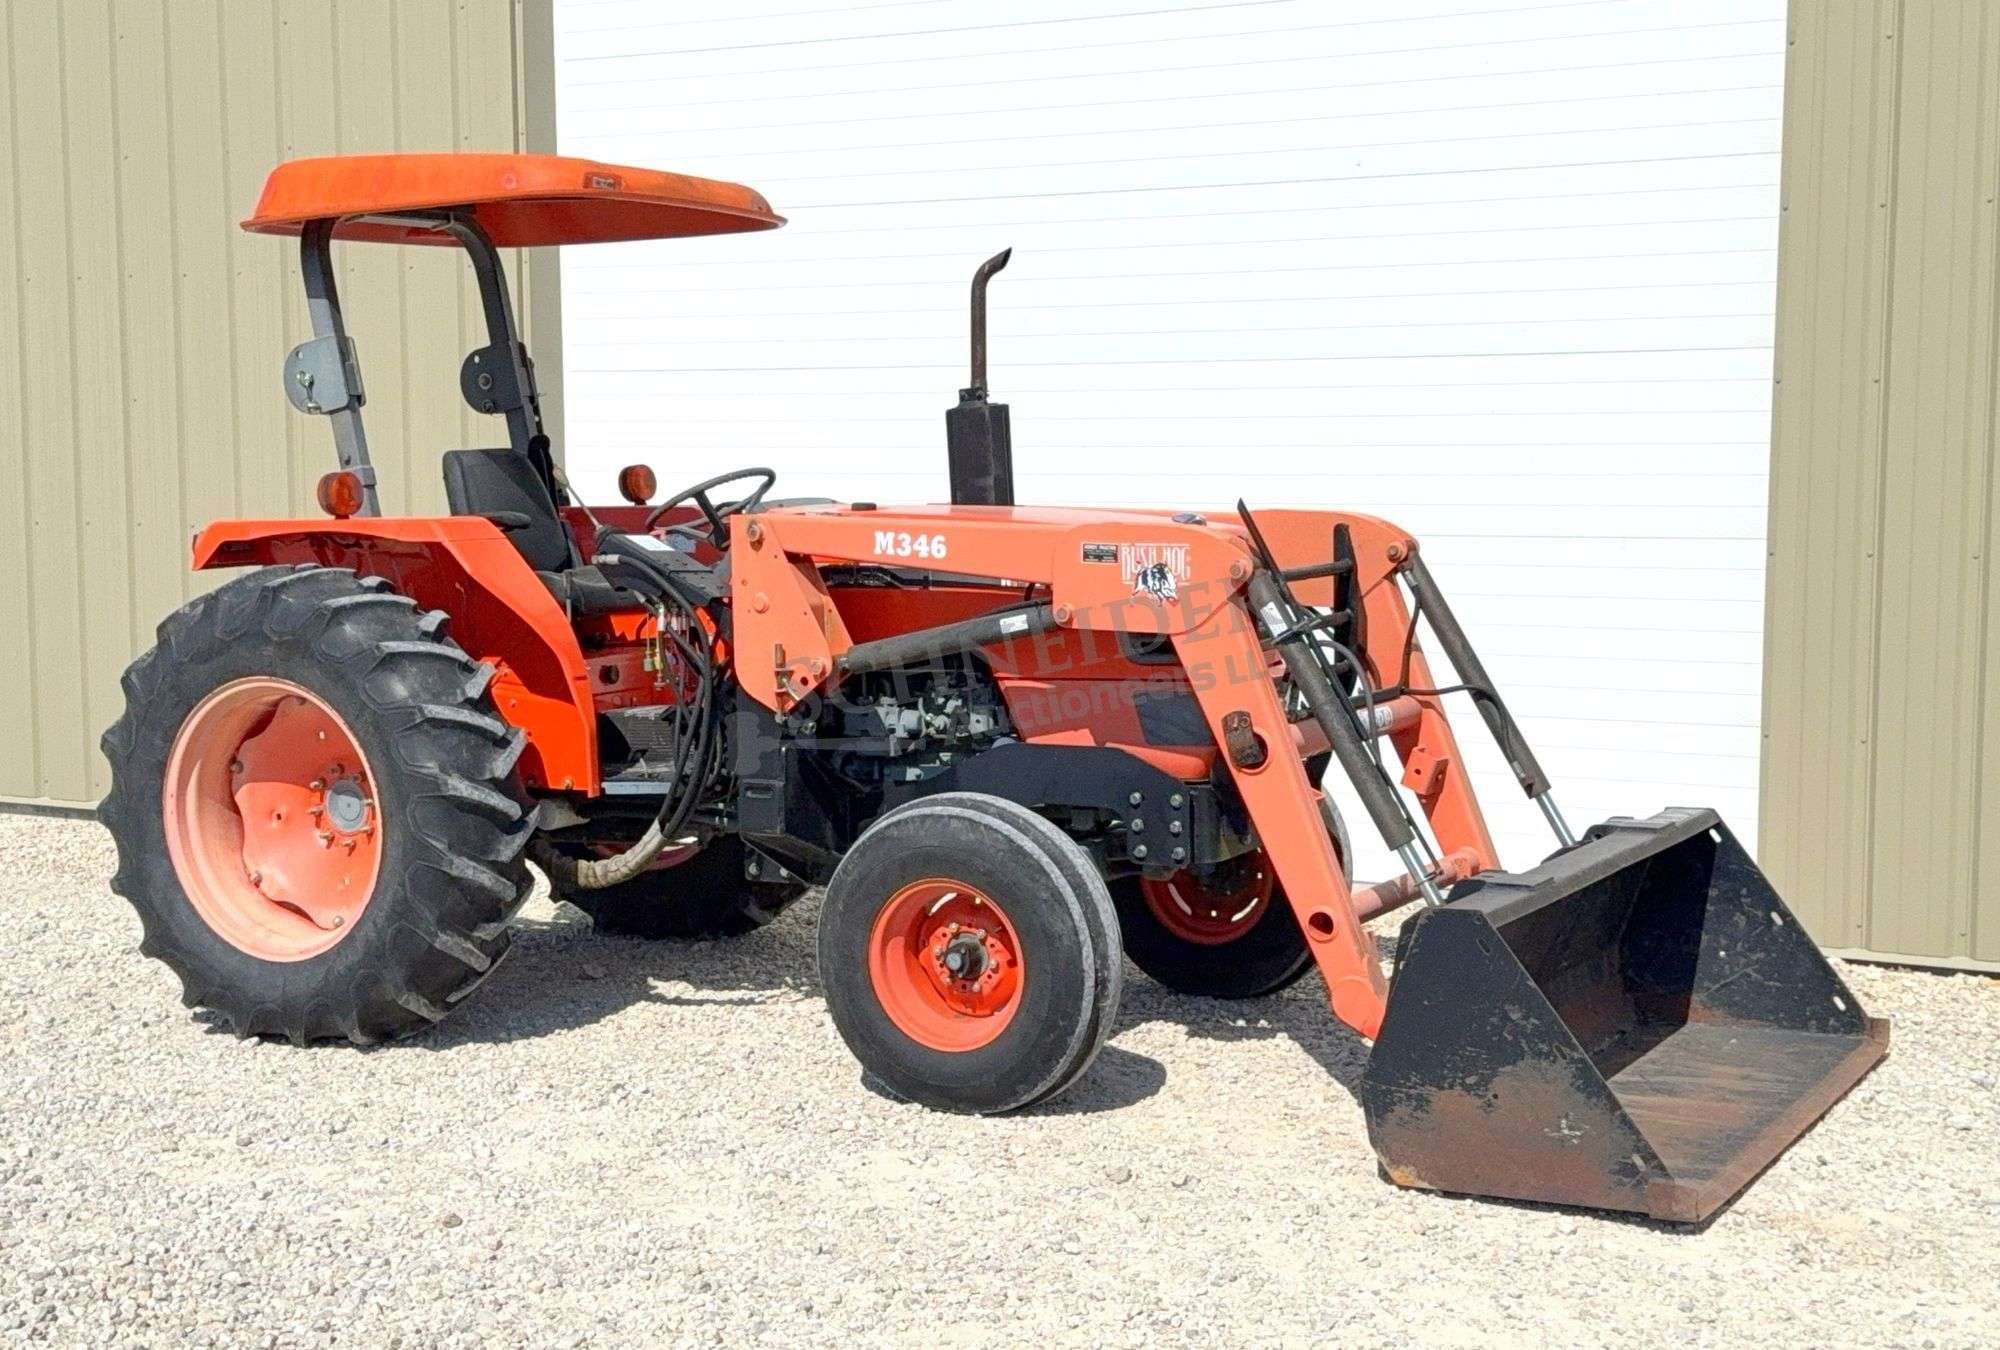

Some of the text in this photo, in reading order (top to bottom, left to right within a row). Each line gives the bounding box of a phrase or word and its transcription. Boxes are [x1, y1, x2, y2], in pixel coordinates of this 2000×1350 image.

[873, 530, 948, 559] M346
[1121, 545, 1158, 583] BUSH
[1162, 545, 1192, 583] HOG
